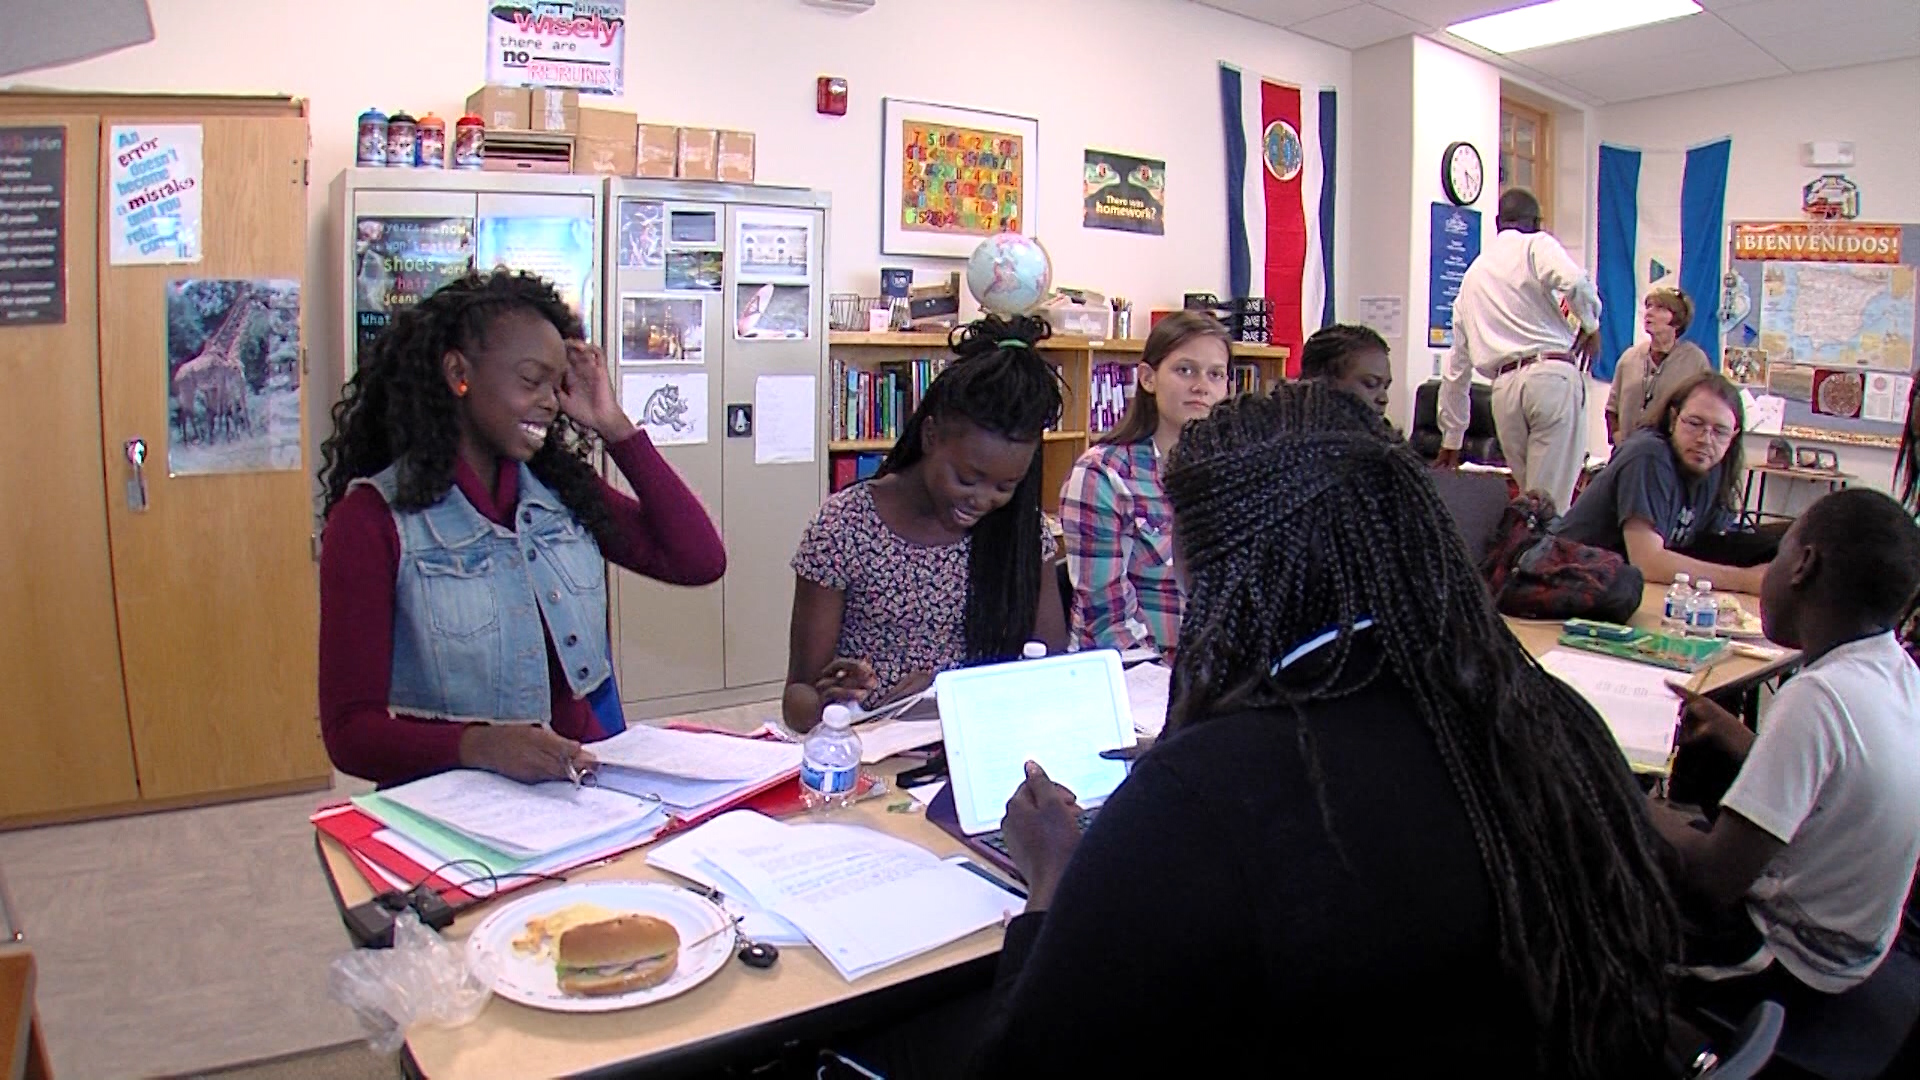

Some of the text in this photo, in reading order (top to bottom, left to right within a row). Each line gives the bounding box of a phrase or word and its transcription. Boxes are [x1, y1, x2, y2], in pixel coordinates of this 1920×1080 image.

[513, 12, 618, 47] wisely
[500, 36, 576, 52] there are
[503, 51, 529, 64] no
[118, 137, 158, 168] error
[1095, 201, 1157, 219] homework?
[1735, 233, 1899, 255] ¡BIENVENIDOS!
[384, 255, 434, 273] shoes
